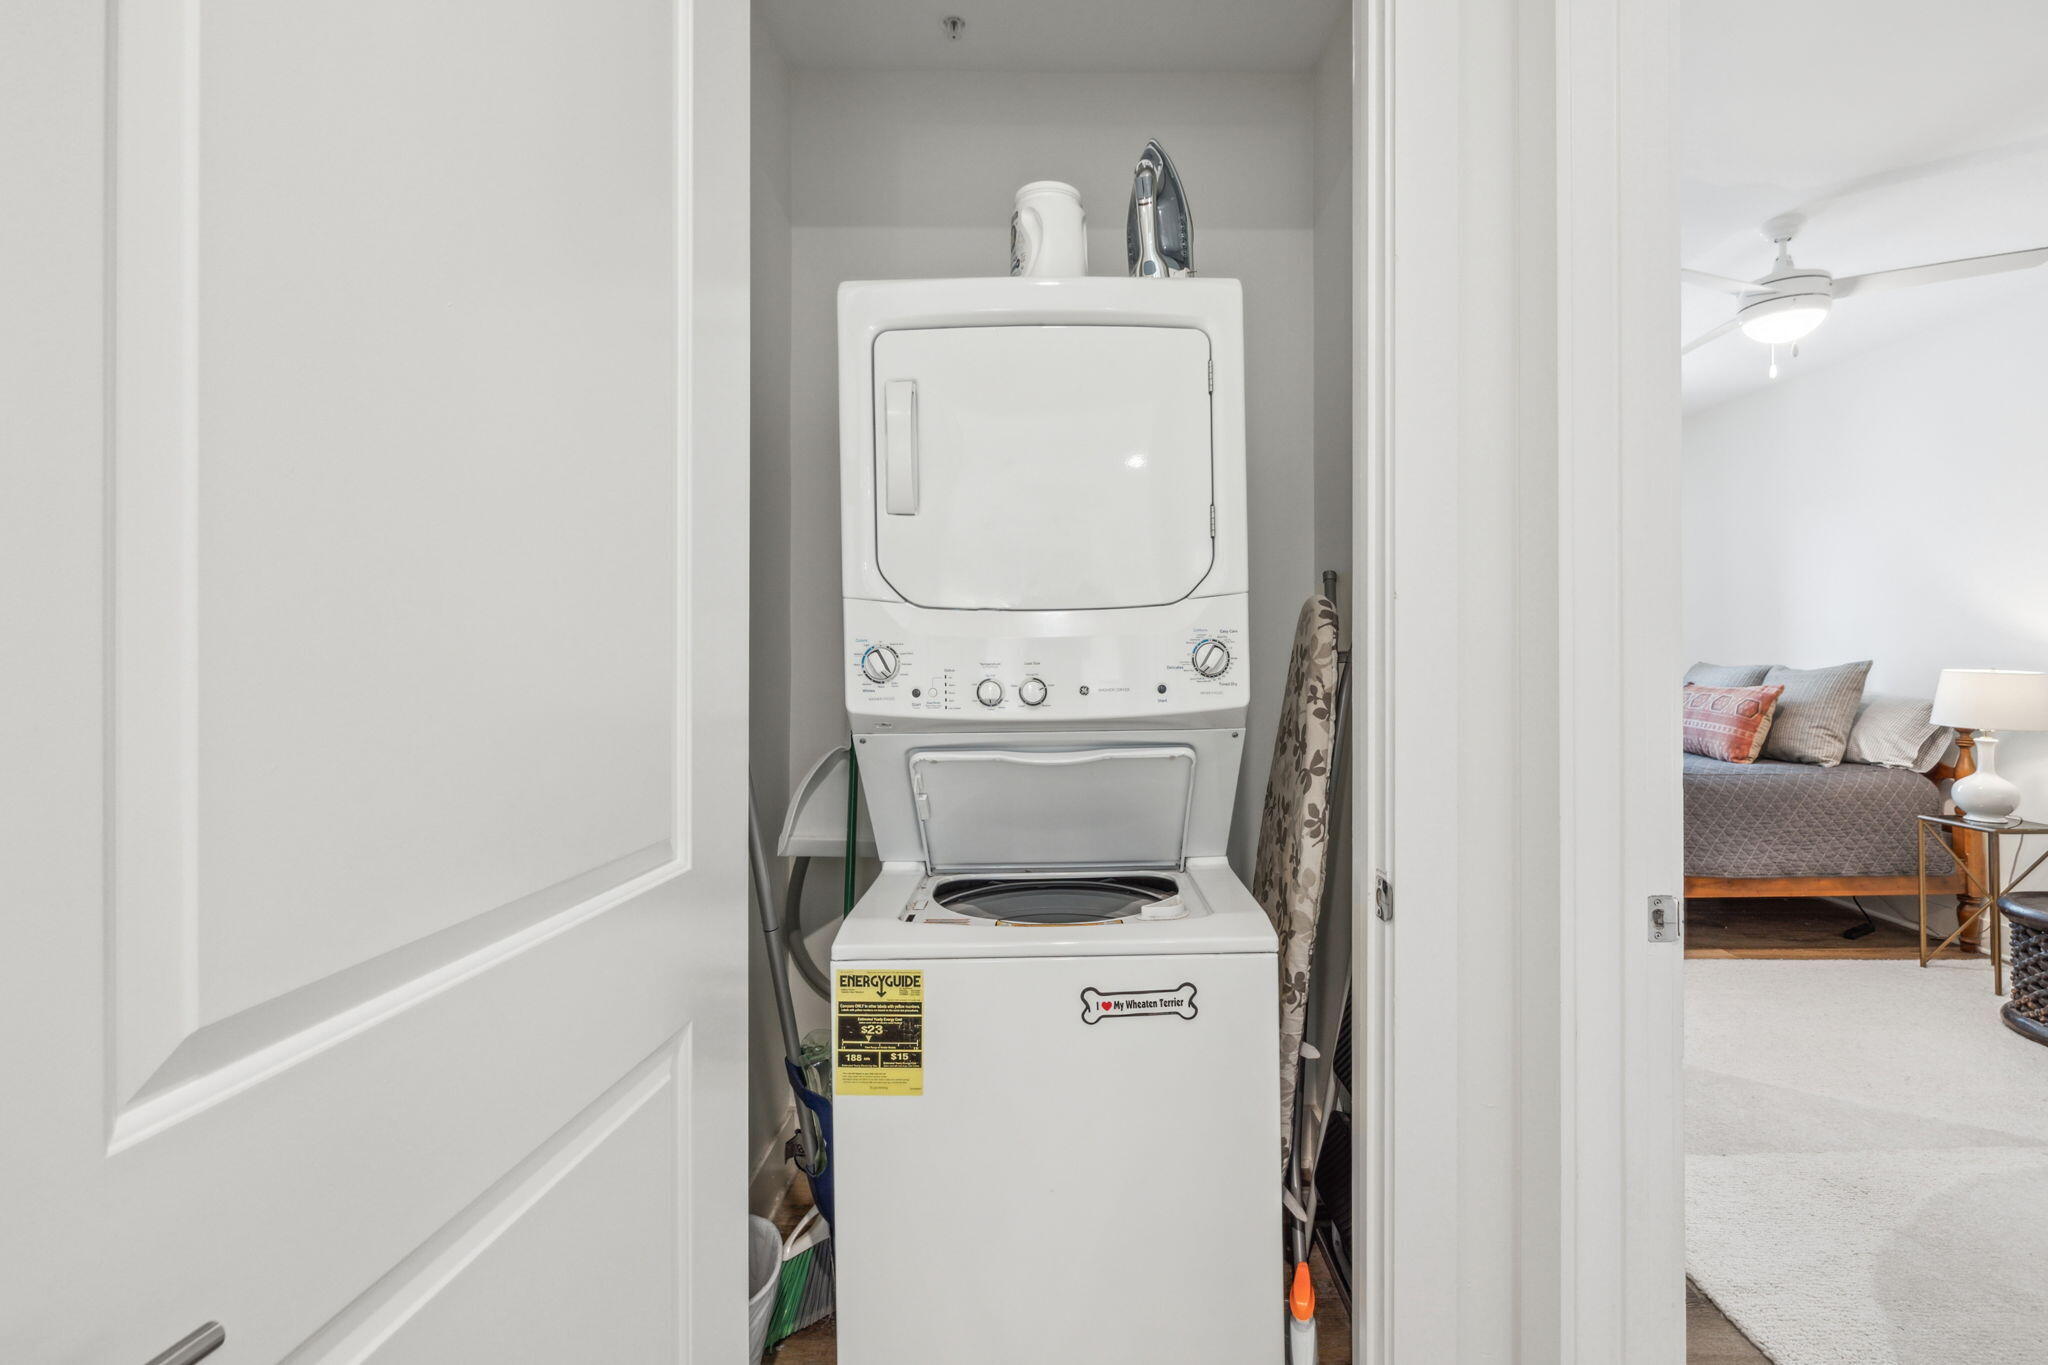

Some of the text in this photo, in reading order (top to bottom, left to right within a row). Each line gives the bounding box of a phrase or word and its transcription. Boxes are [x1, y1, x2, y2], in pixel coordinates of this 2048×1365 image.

[840, 974, 921, 988] ENERGYGUIDE
[1096, 997, 1184, 1011] I My Wheaten Terrier
[861, 1024, 884, 1035] $23
[845, 1053, 862, 1062] 188
[890, 1052, 909, 1061] $15
